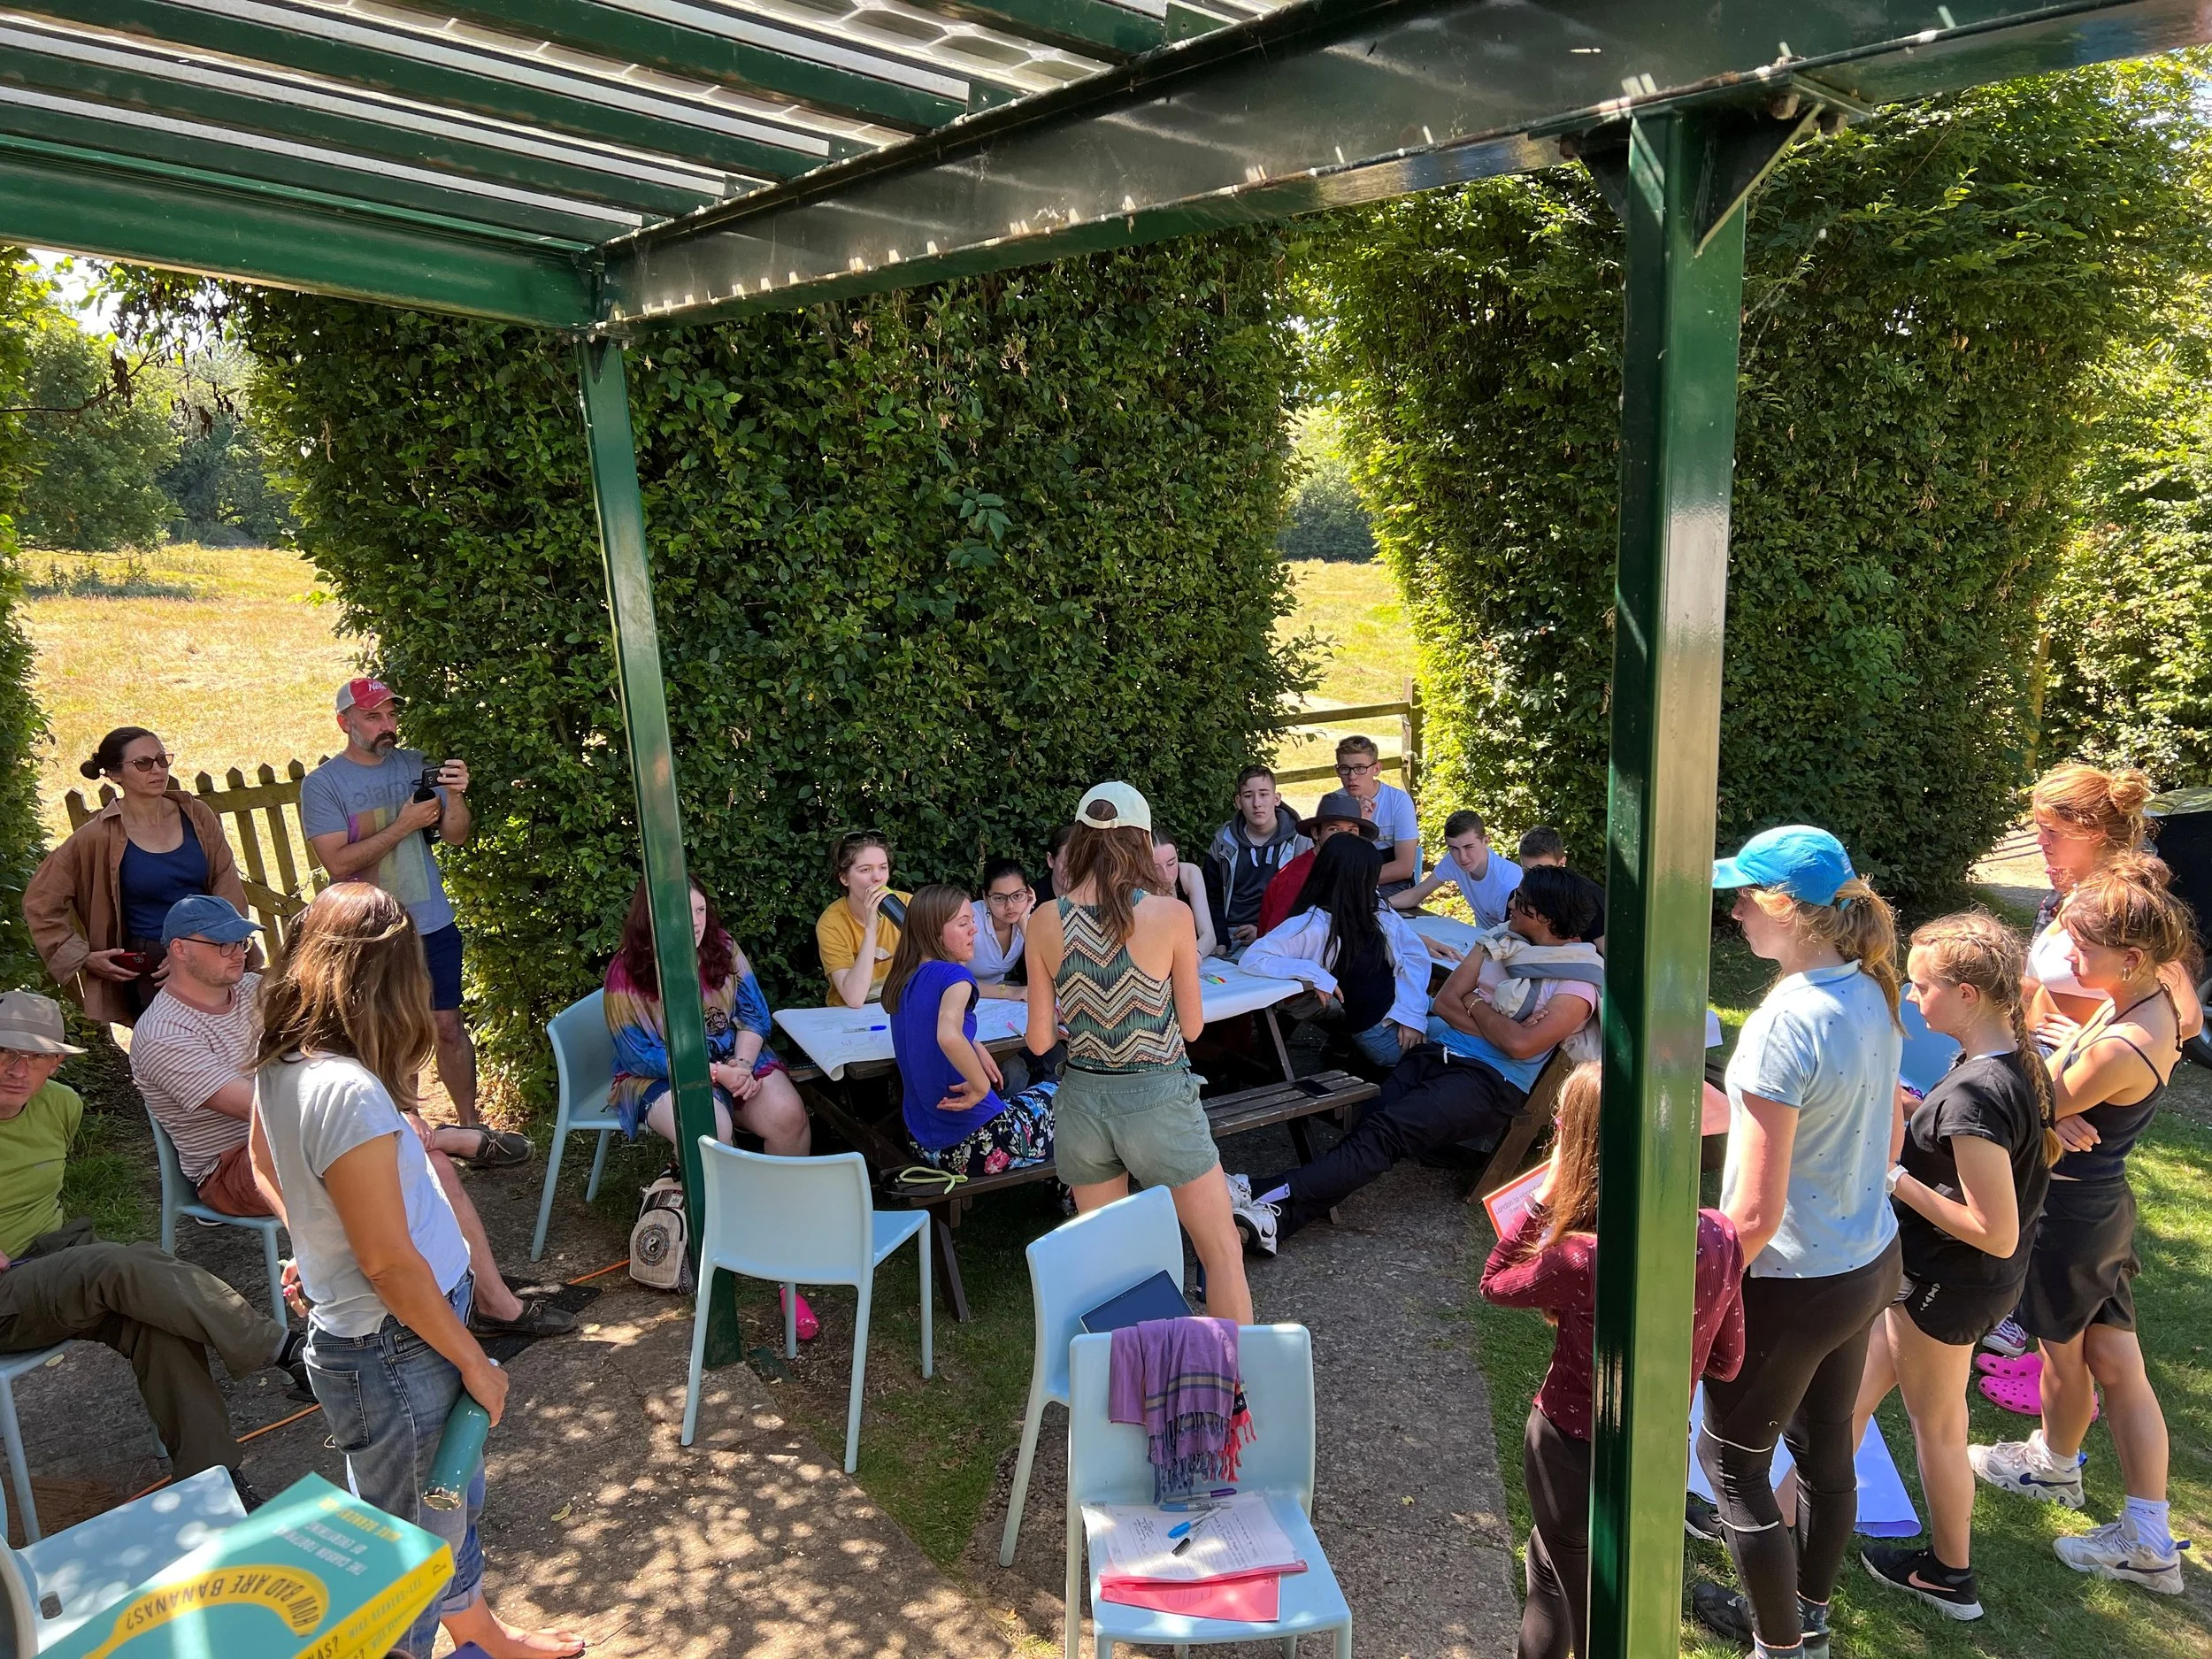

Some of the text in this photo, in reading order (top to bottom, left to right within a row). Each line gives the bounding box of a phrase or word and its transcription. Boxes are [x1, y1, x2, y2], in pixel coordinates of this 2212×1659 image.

[126, 1573, 320, 1631] HOW BAD ARE BANANAS?
